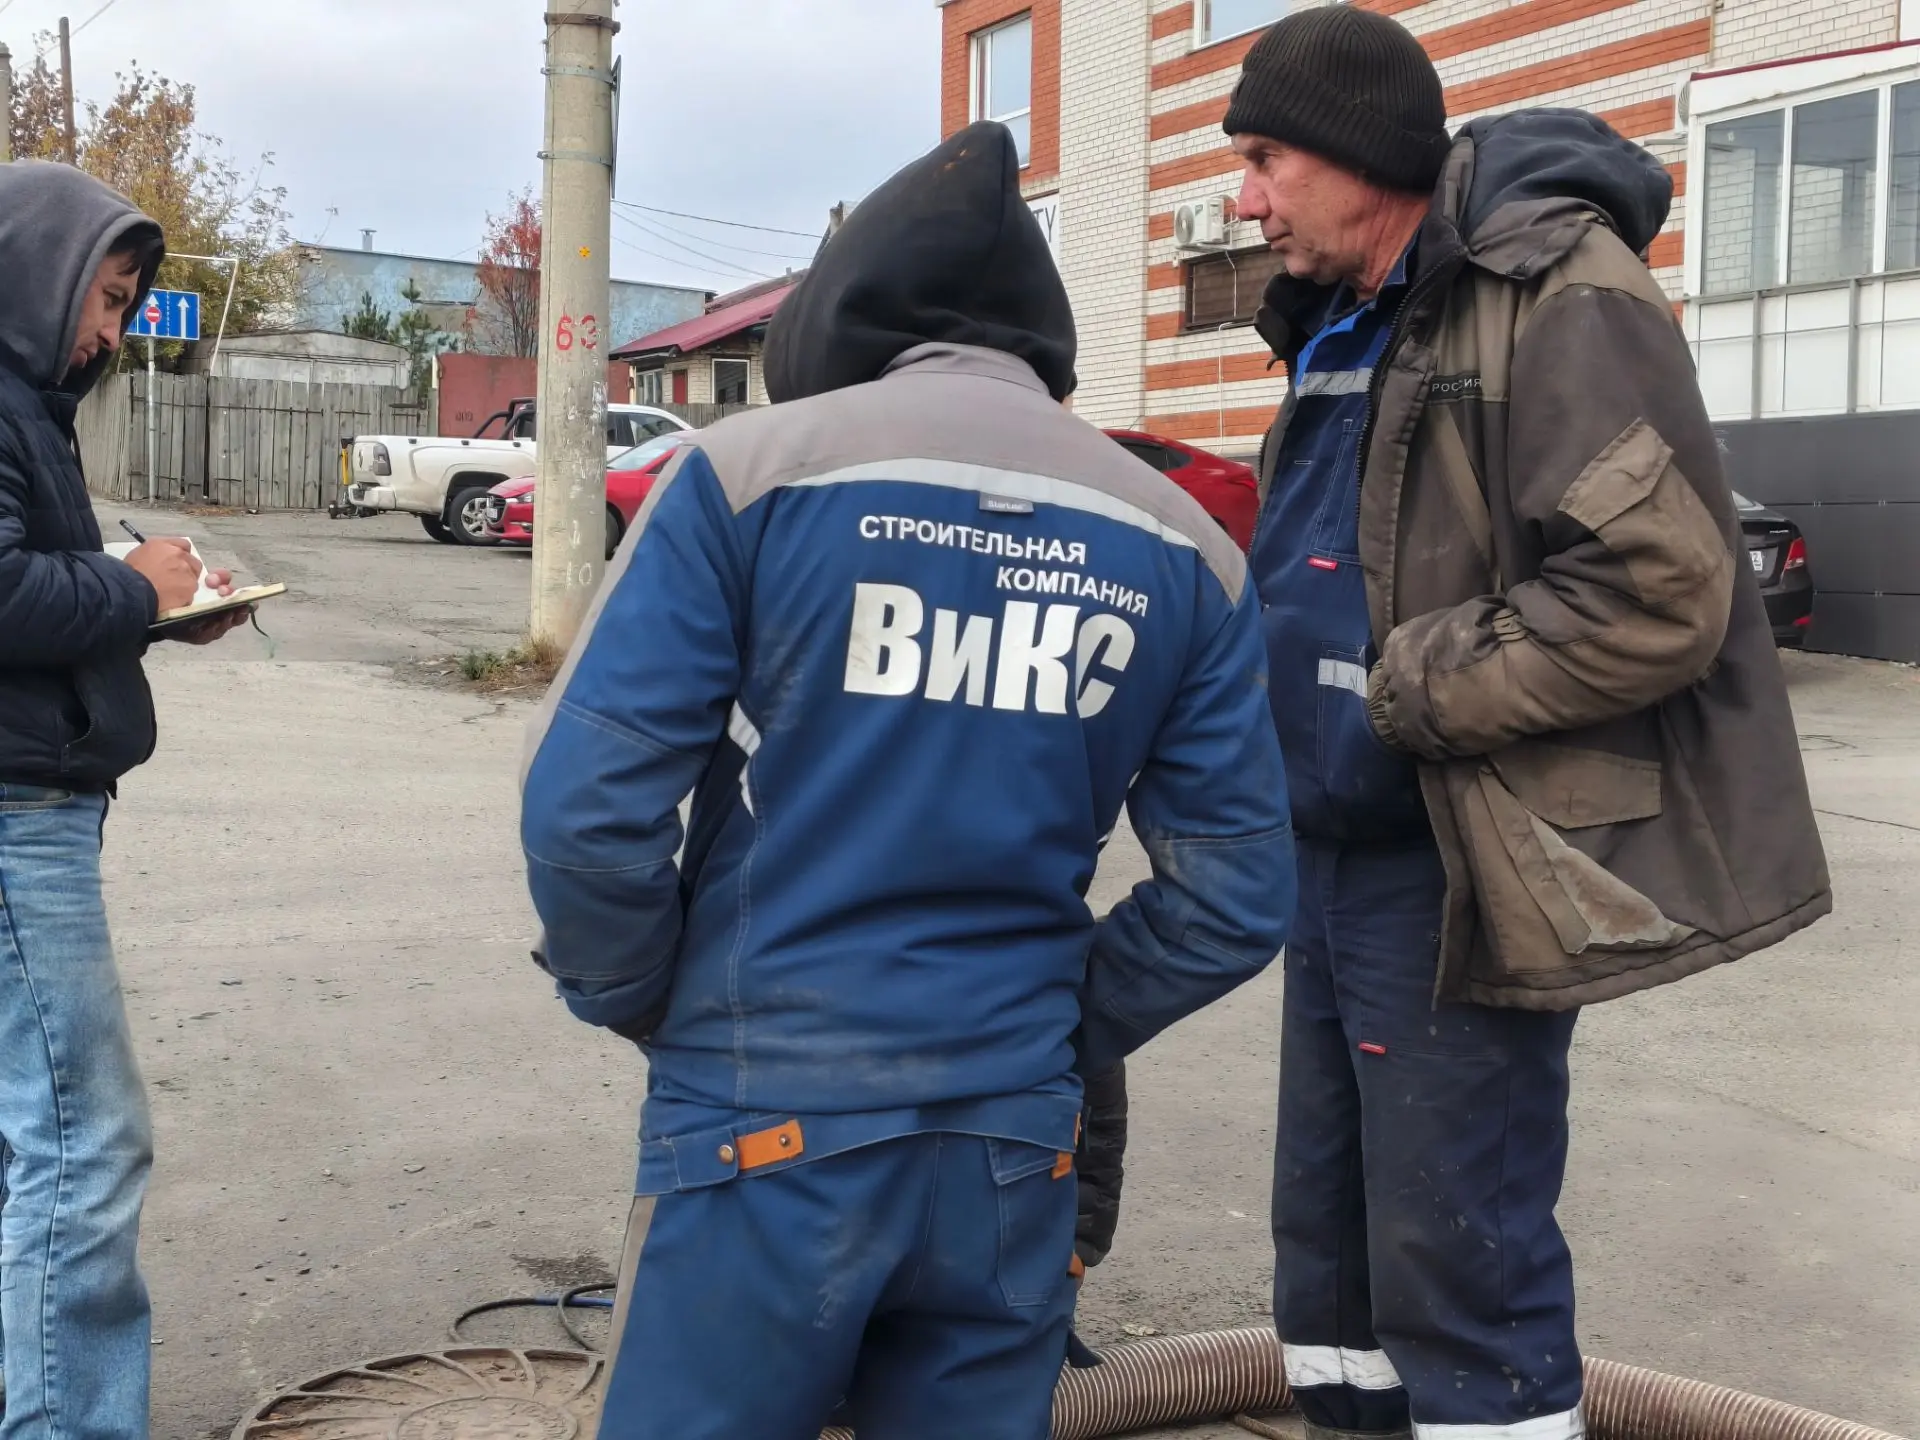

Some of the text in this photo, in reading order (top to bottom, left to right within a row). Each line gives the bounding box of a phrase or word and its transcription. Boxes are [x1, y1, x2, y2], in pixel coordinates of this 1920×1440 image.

[556, 314, 597, 350] 63
[859, 515, 1086, 564] СТРОИТЕЛЬНАЯ
[996, 566, 1148, 617] КОМПАНИЯ
[843, 582, 1135, 719] ВиКС
